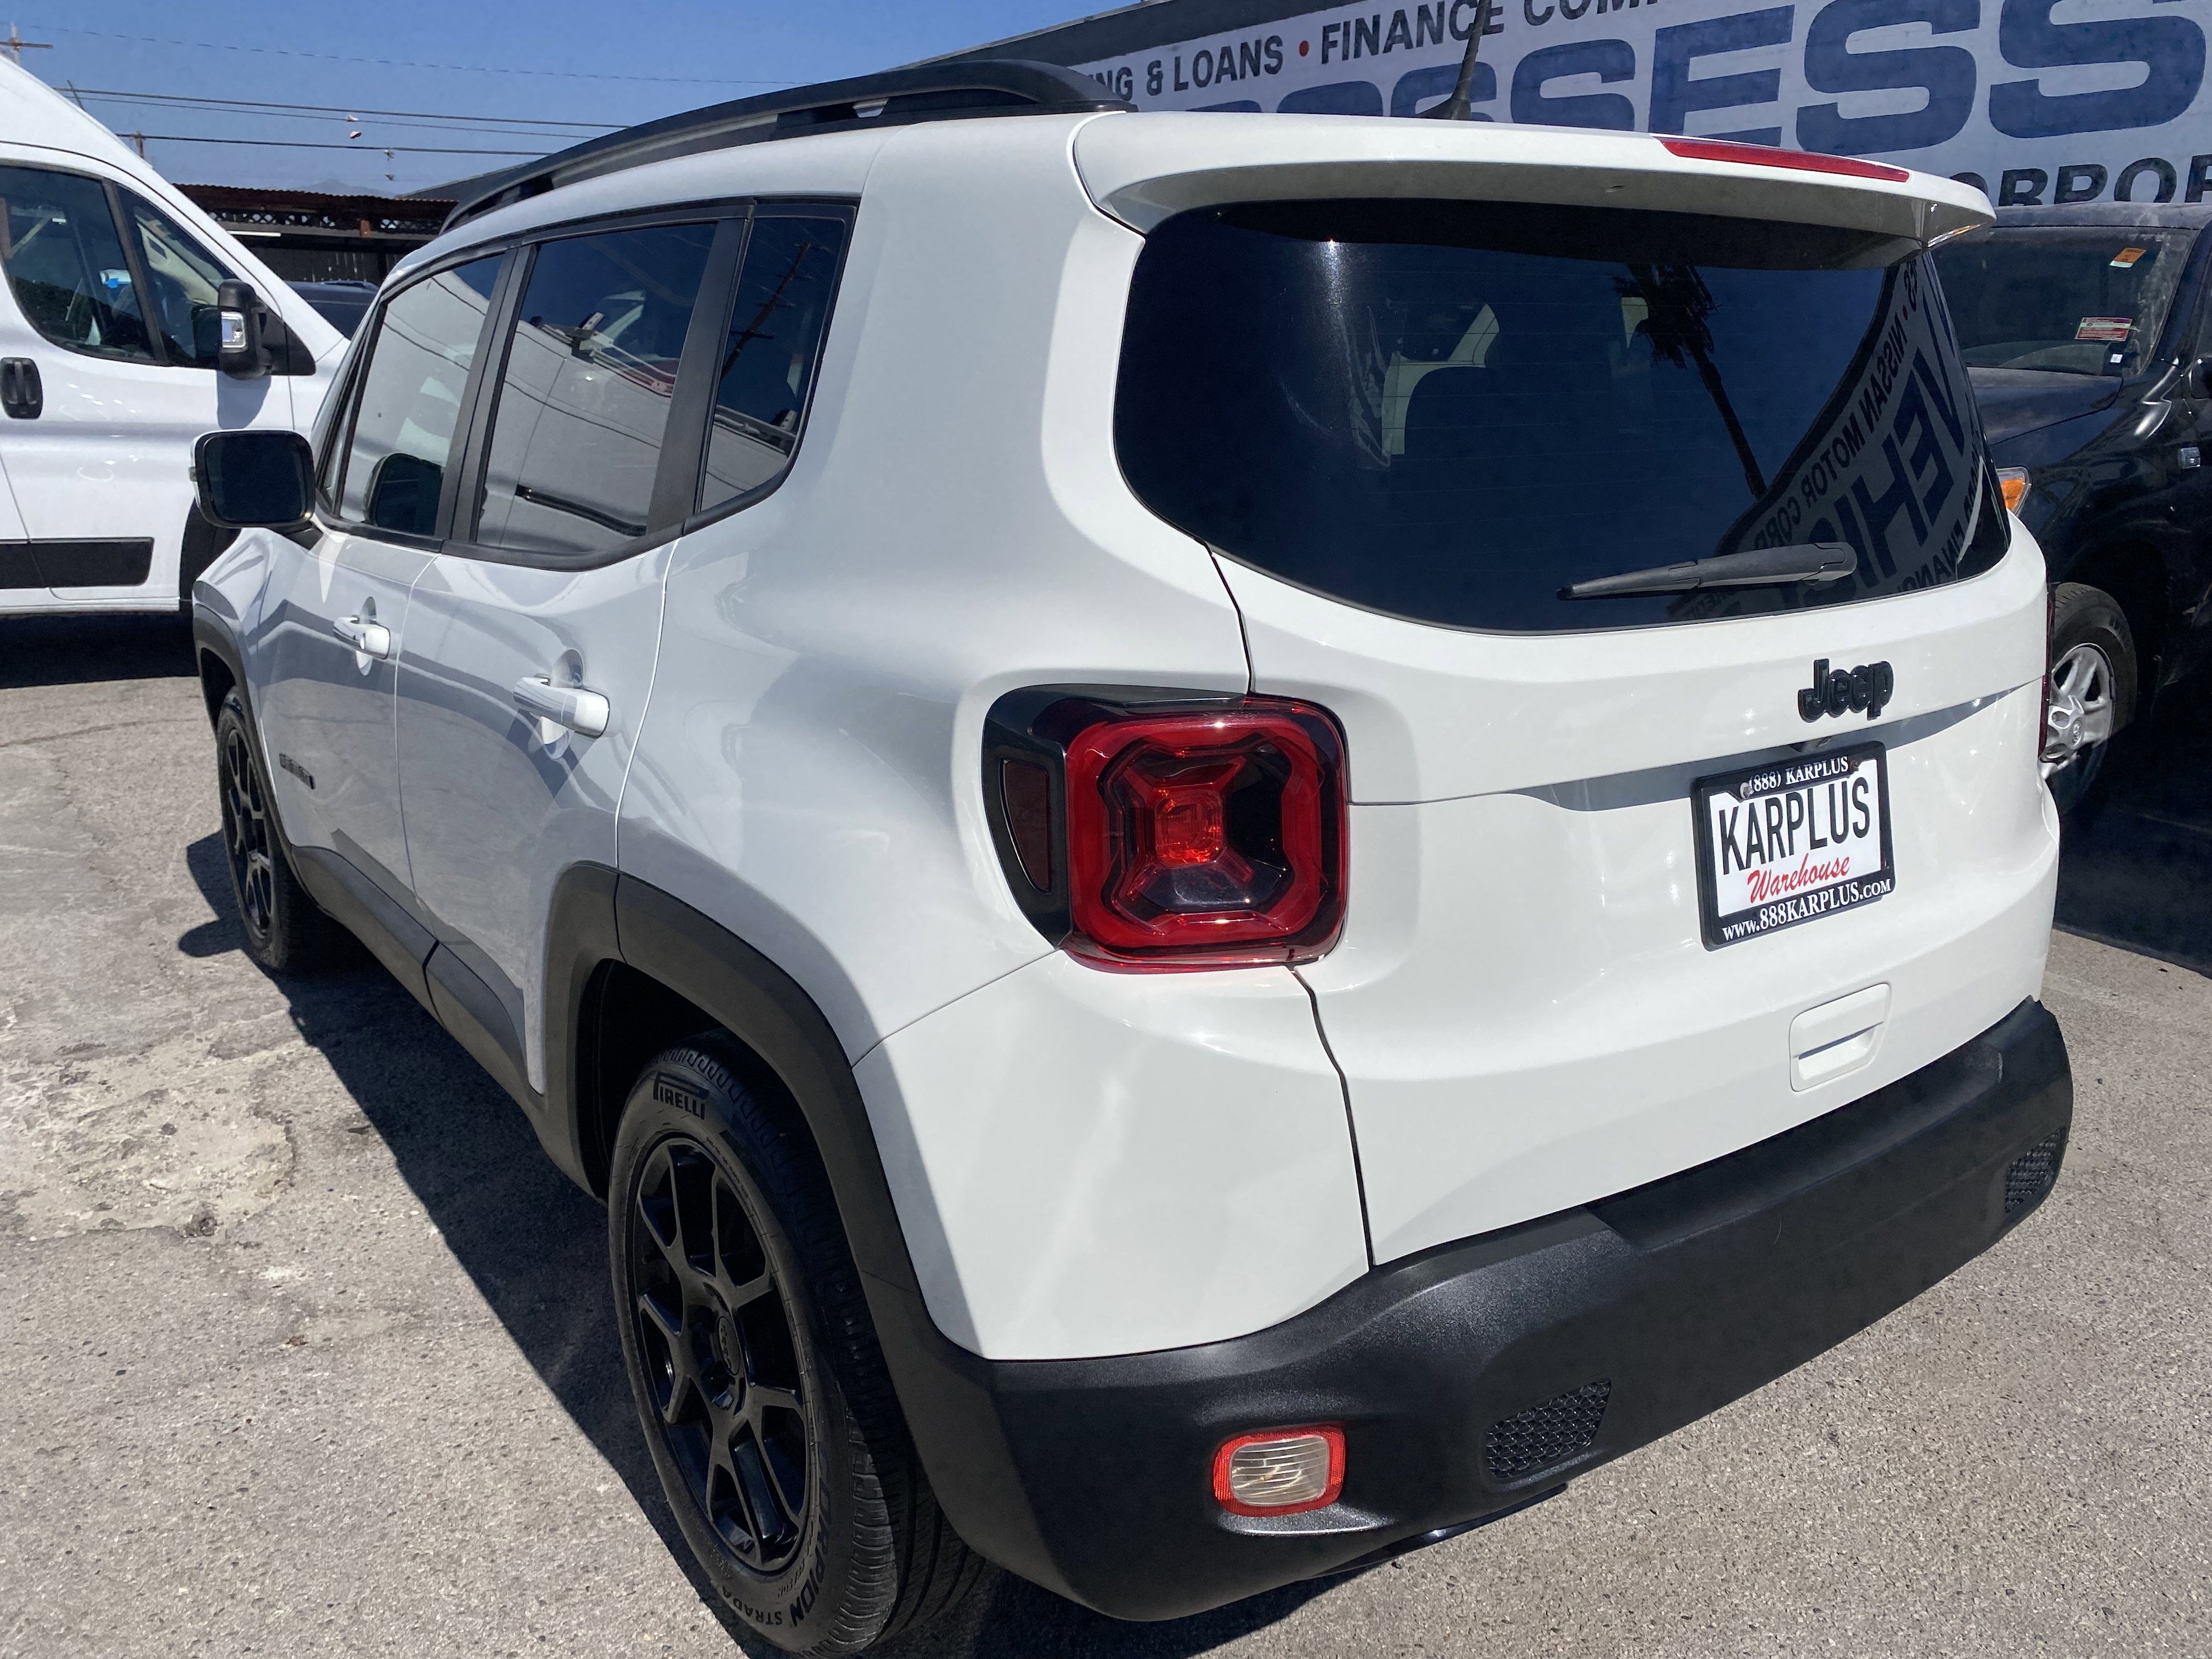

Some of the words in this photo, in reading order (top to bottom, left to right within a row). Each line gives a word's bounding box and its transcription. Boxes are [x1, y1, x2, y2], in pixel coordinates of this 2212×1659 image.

[1088, 66, 1133, 101] NG
[1146, 60, 1164, 96] &
[1174, 35, 1283, 92] LOANS
[1321, 0, 1504, 64] FINANCE
[1798, 658, 1894, 723] Jeep
[1786, 756, 1849, 785] KARPLUS
[1719, 776, 1870, 876] KARPLUS
[1747, 853, 1850, 904] Warehouse
[653, 1071, 710, 1120] PIRELLI
[720, 1584, 783, 1626] STRADA
